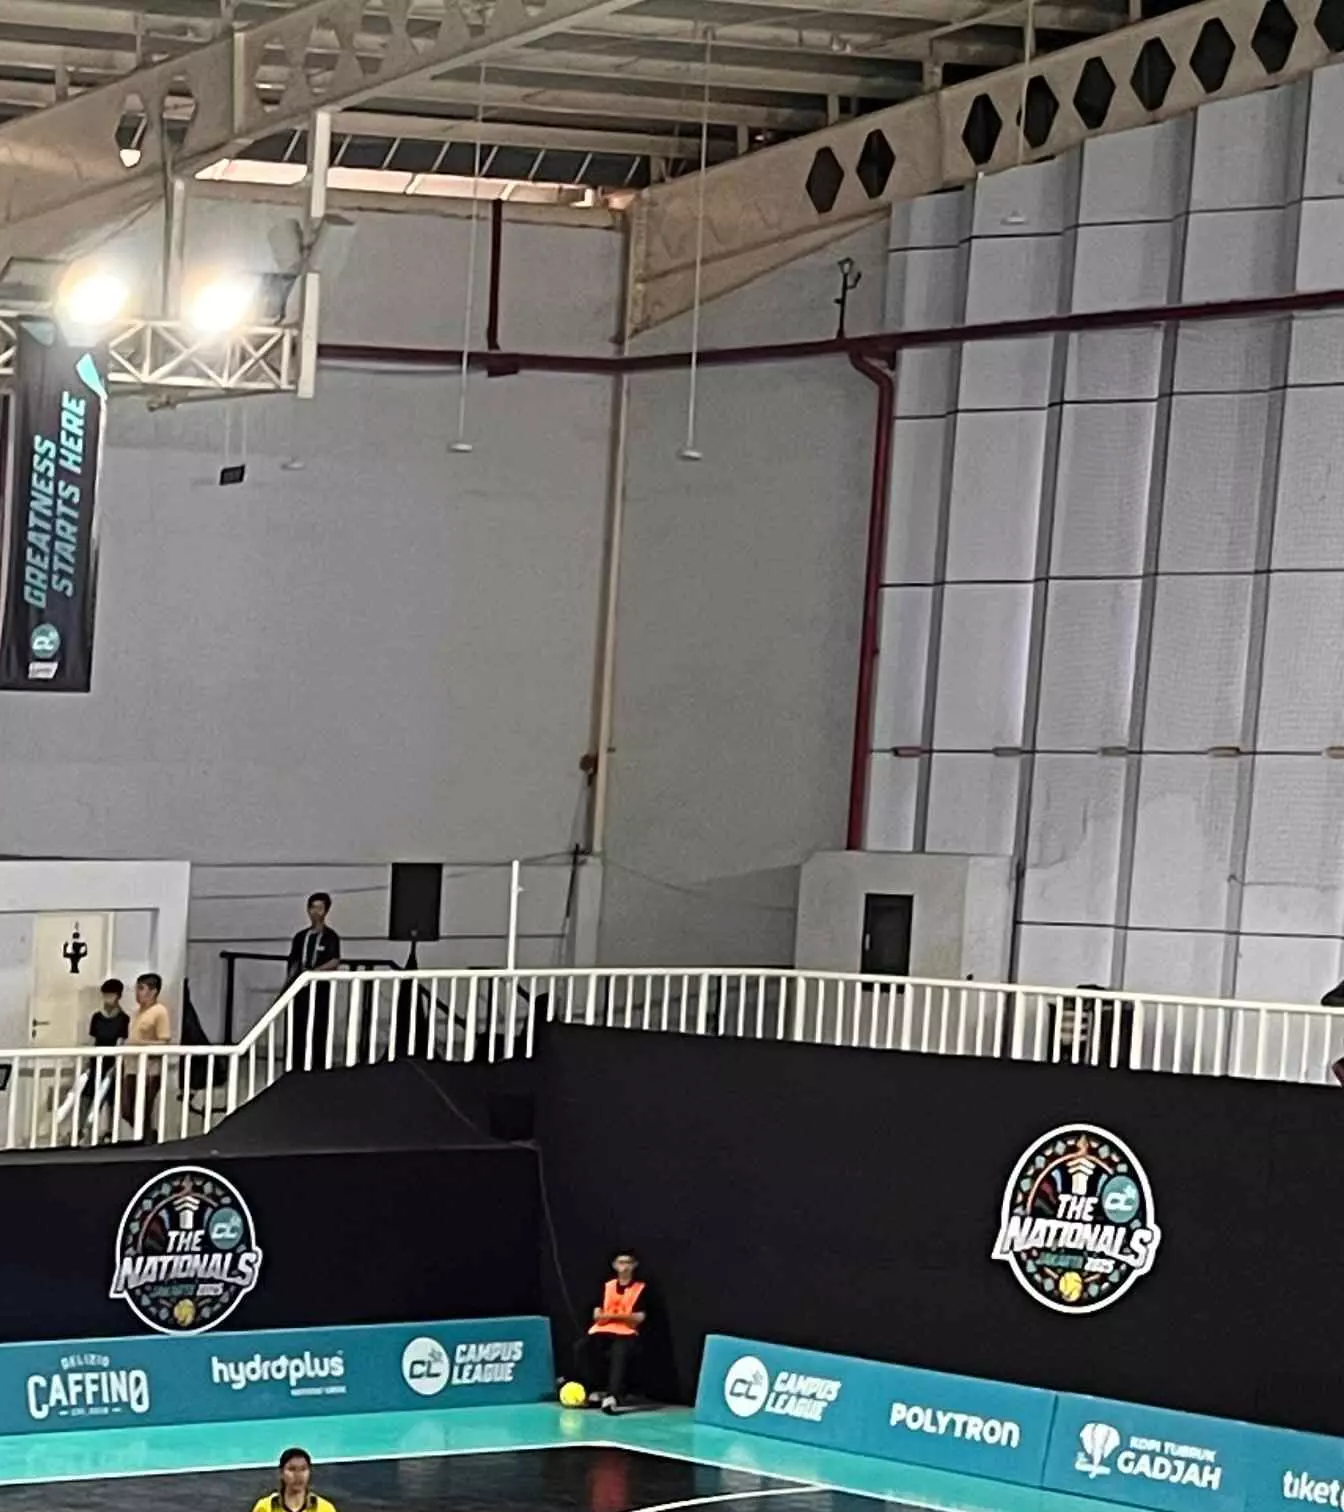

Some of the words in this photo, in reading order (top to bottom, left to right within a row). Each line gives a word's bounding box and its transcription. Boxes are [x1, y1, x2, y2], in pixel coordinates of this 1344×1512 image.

[58, 391, 86, 474] HERE
[24, 434, 56, 608] GREATNESS
[51, 479, 80, 597] STARTS
[1056, 1193, 1099, 1222] THE
[166, 1229, 205, 1253] THE
[1004, 1216, 1154, 1269] NATIONALS
[117, 1252, 257, 1292] NATIONALS
[211, 1350, 345, 1390] hydroplus
[455, 1341, 524, 1363] CAMPUS
[451, 1362, 517, 1385] LEAGUE
[772, 1370, 842, 1402] CAMPUS
[27, 1369, 150, 1420] CAFFINO
[889, 1402, 1022, 1449] POLYTRON
[1116, 1450, 1223, 1491] GADJAH
